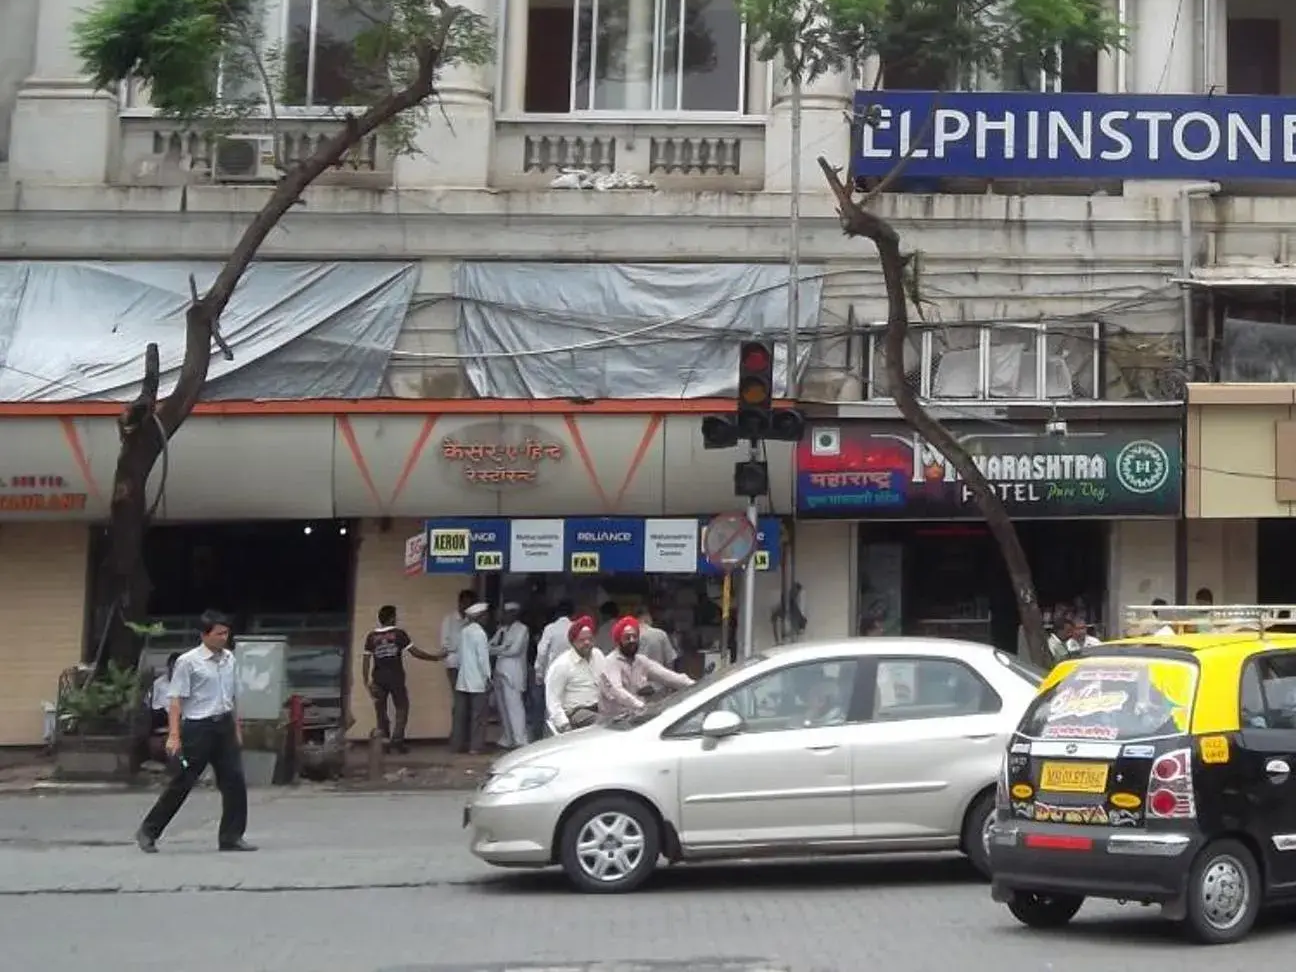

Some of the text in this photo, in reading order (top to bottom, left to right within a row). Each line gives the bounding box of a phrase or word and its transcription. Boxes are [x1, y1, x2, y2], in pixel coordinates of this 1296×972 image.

[434, 534, 466, 551] XEROX
[477, 554, 501, 566] FAX
[574, 556, 597, 569] FAX
